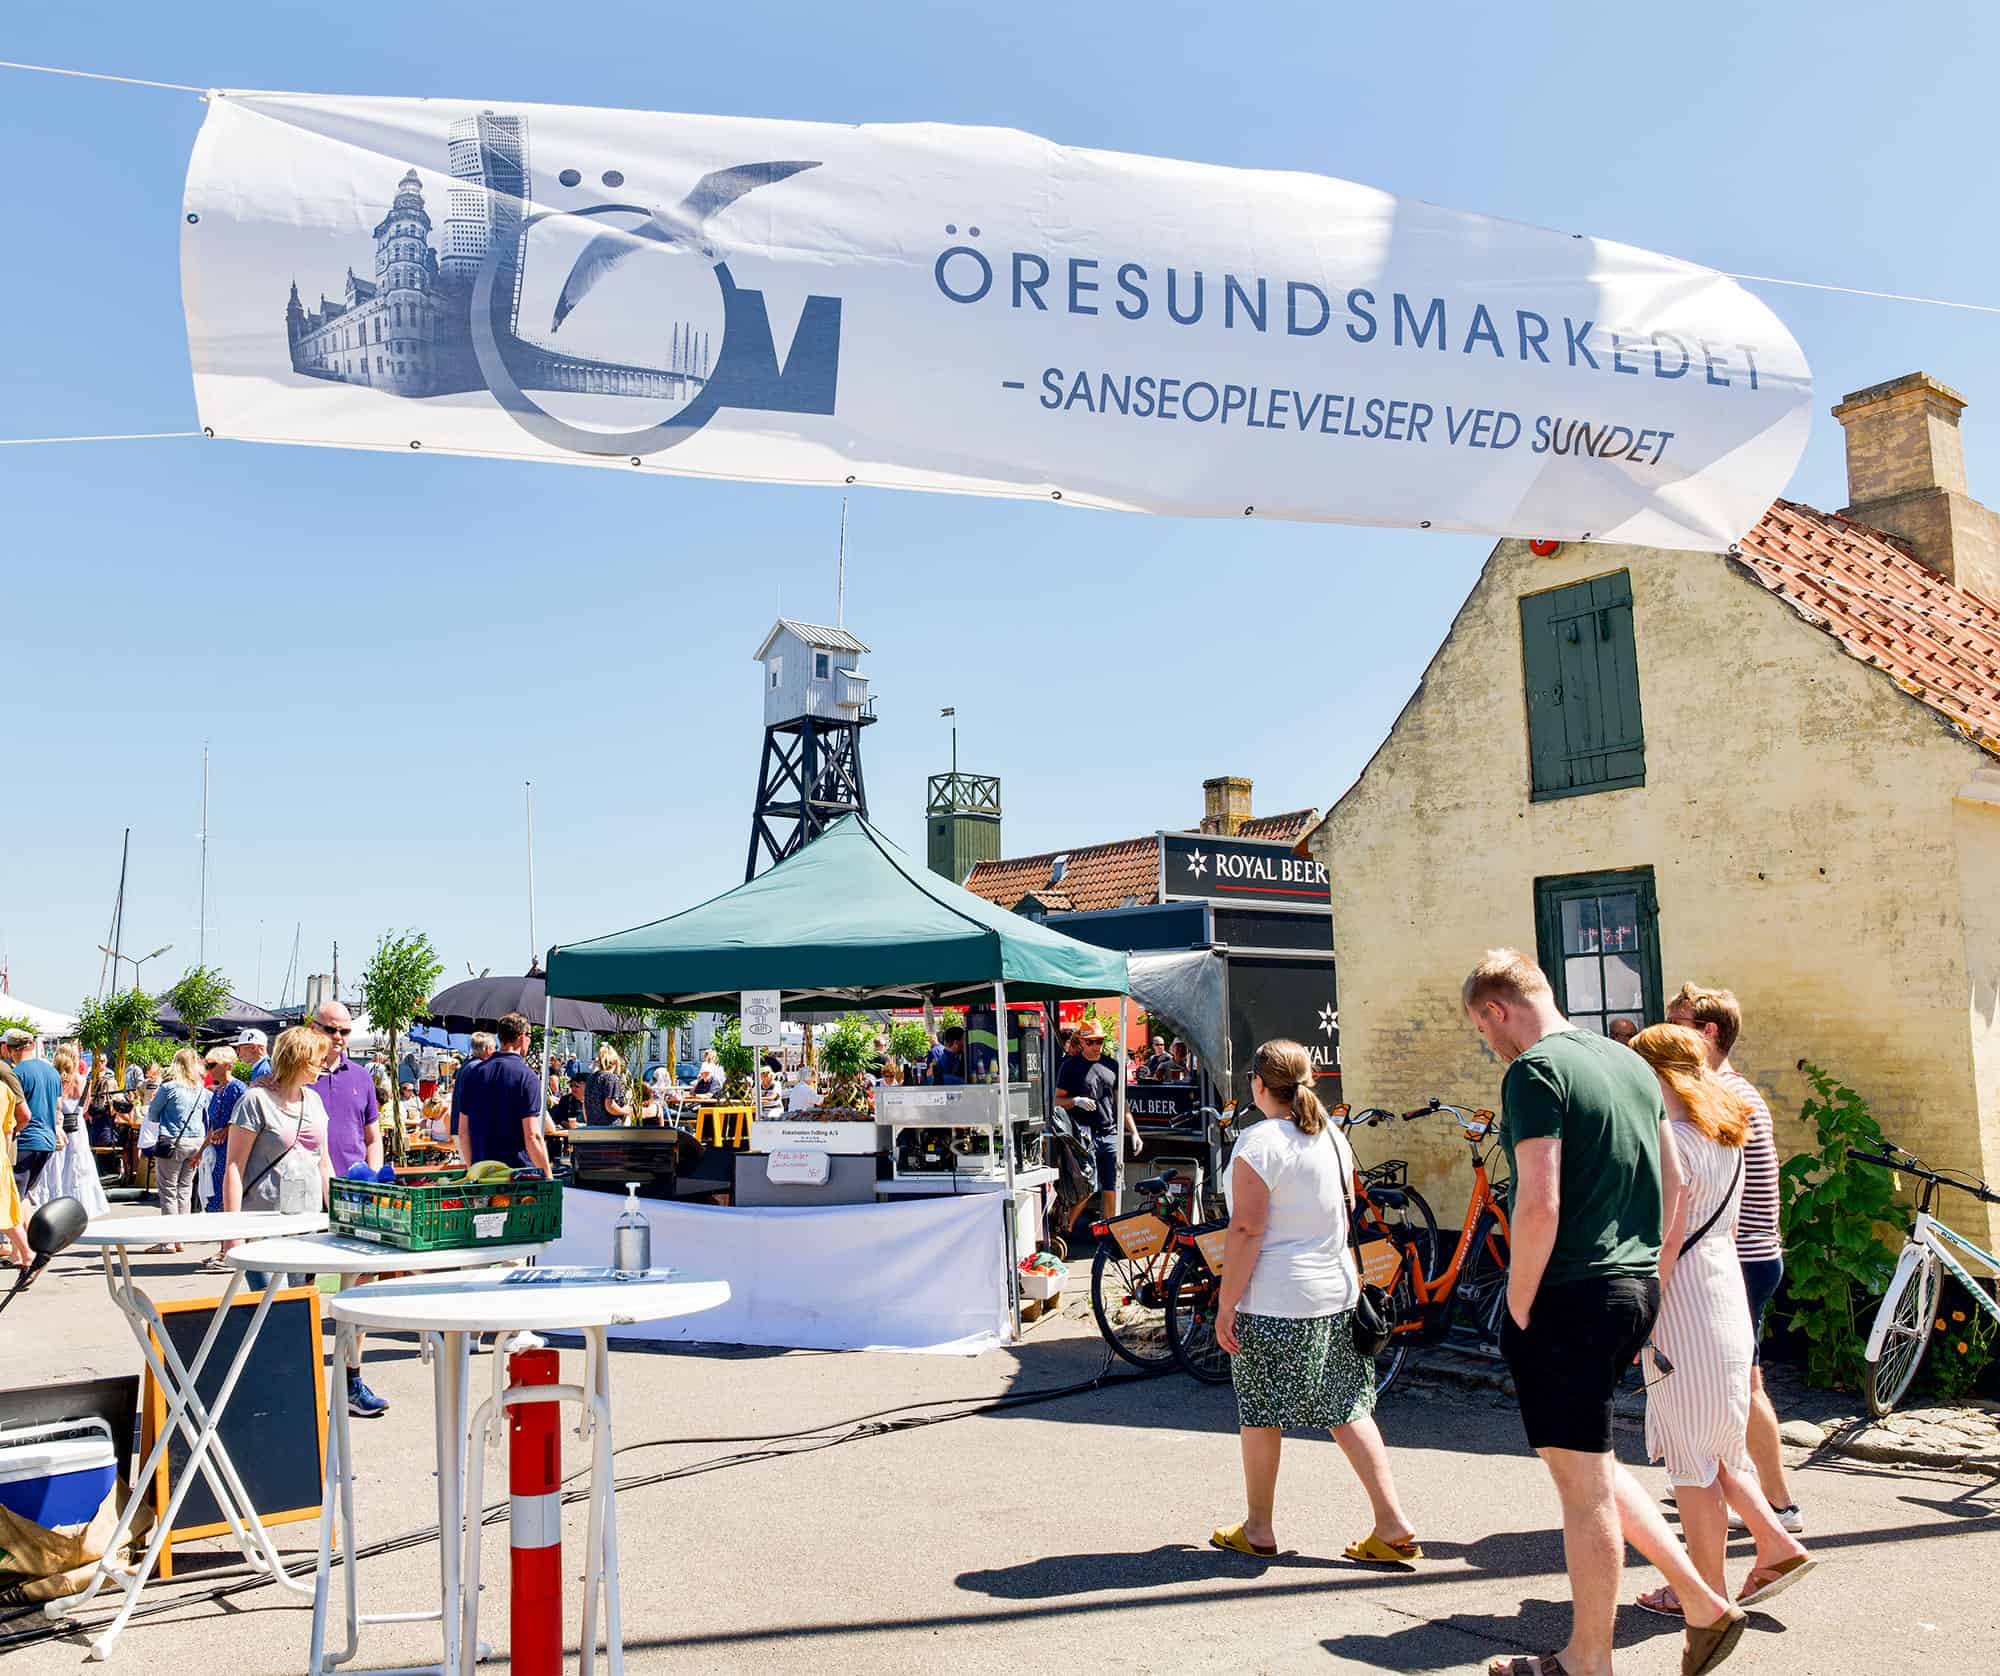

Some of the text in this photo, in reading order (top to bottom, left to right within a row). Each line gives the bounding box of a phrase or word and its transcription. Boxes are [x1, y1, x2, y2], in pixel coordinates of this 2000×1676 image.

[934, 223, 1760, 391] ÖRESUNDSMARKEDET
[1040, 367, 1428, 443] SANSEOPLEVELSER
[1445, 405, 1522, 450] VED
[1531, 415, 1675, 466] SUNDET
[1215, 853, 1329, 884] ROYAL BEER
[1303, 1045, 1334, 1066] YAL
[1126, 1098, 1178, 1115] YAL BEER
